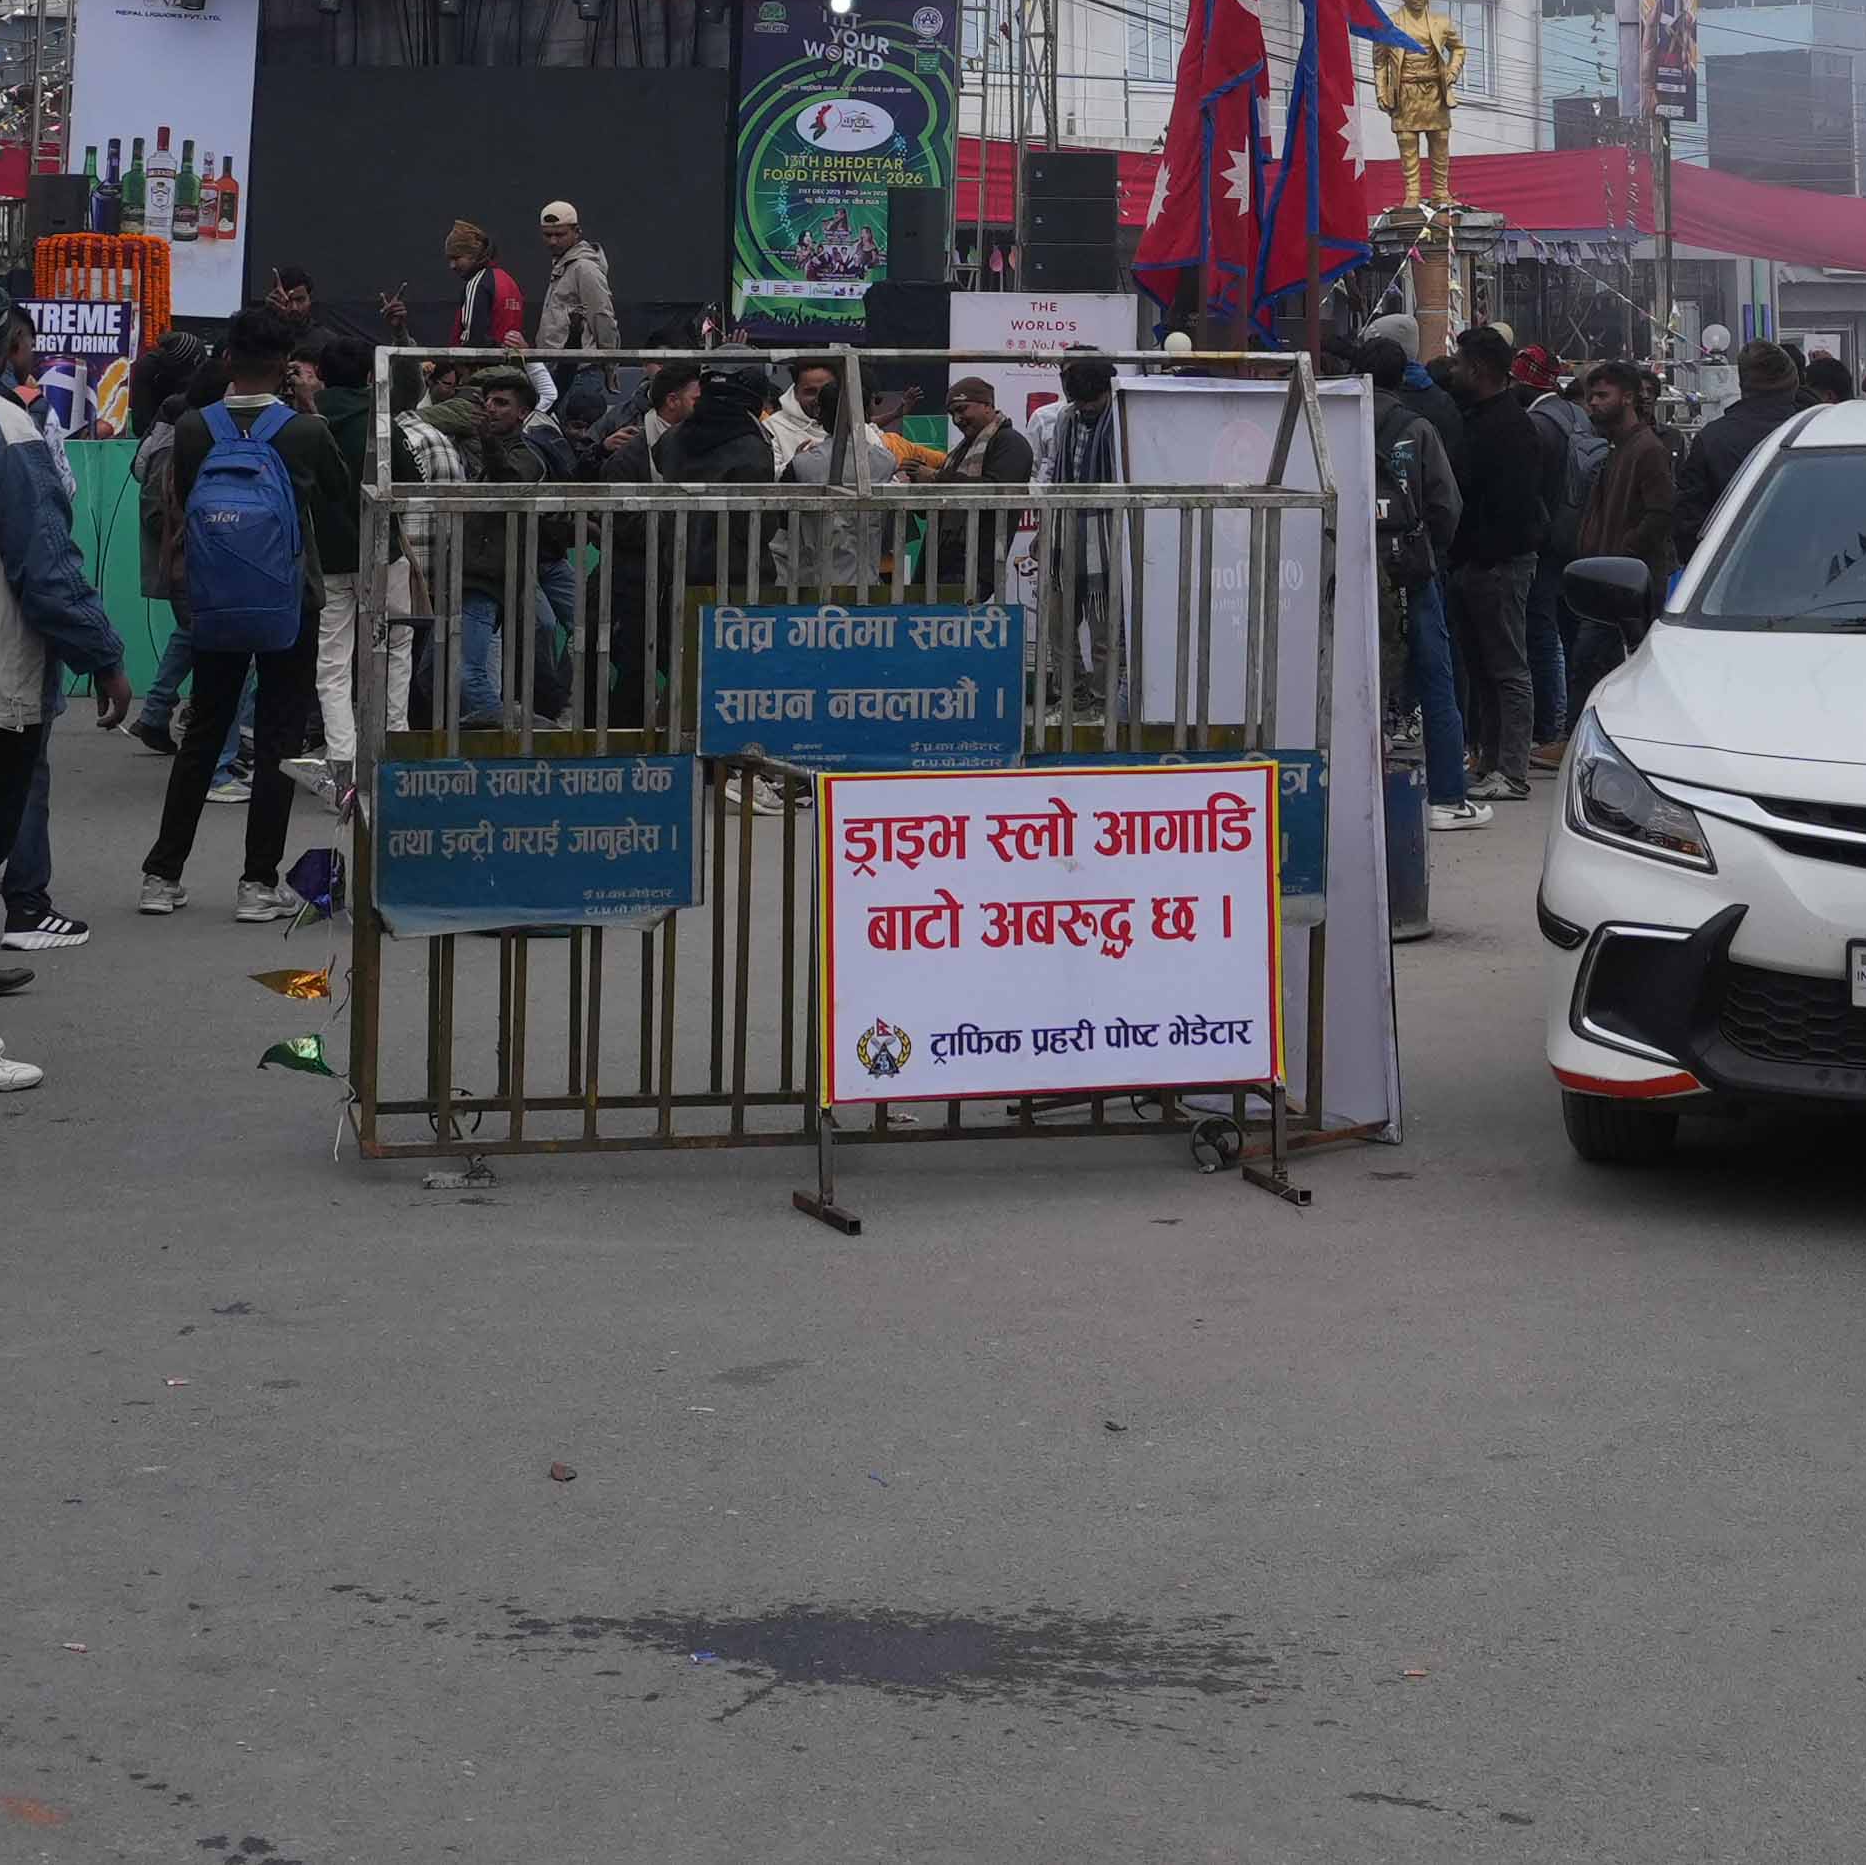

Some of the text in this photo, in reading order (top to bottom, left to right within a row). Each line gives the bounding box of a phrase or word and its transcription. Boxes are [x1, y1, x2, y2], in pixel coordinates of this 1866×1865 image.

[802, 38, 885, 71] WORLD
[828, 25, 890, 55] YOUR
[763, 169, 808, 182] FOOD
[823, 155, 904, 171] BHEDETAR
[18, 302, 122, 334] TREME
[1030, 302, 1058, 312] THE
[1011, 320, 1077, 332] WORLD'S
[71, 336, 120, 353] DRINK
[787, 605, 898, 651] गतिमा
[715, 688, 817, 724] साधन
[486, 761, 553, 797] सवारी
[559, 766, 625, 796] साधन
[388, 829, 434, 858] तथा
[440, 819, 495, 862] इन्ट्री
[502, 820, 560, 857] गराई
[567, 817, 662, 861] जानुहोस
[843, 791, 1257, 877] ड्राइभ स्लो आगाडि
[867, 888, 964, 951] बाटो
[1151, 895, 1199, 942] छ
[930, 1013, 1256, 1064] ट्राफिक प्रहरी पोष्ट भेडेटार
